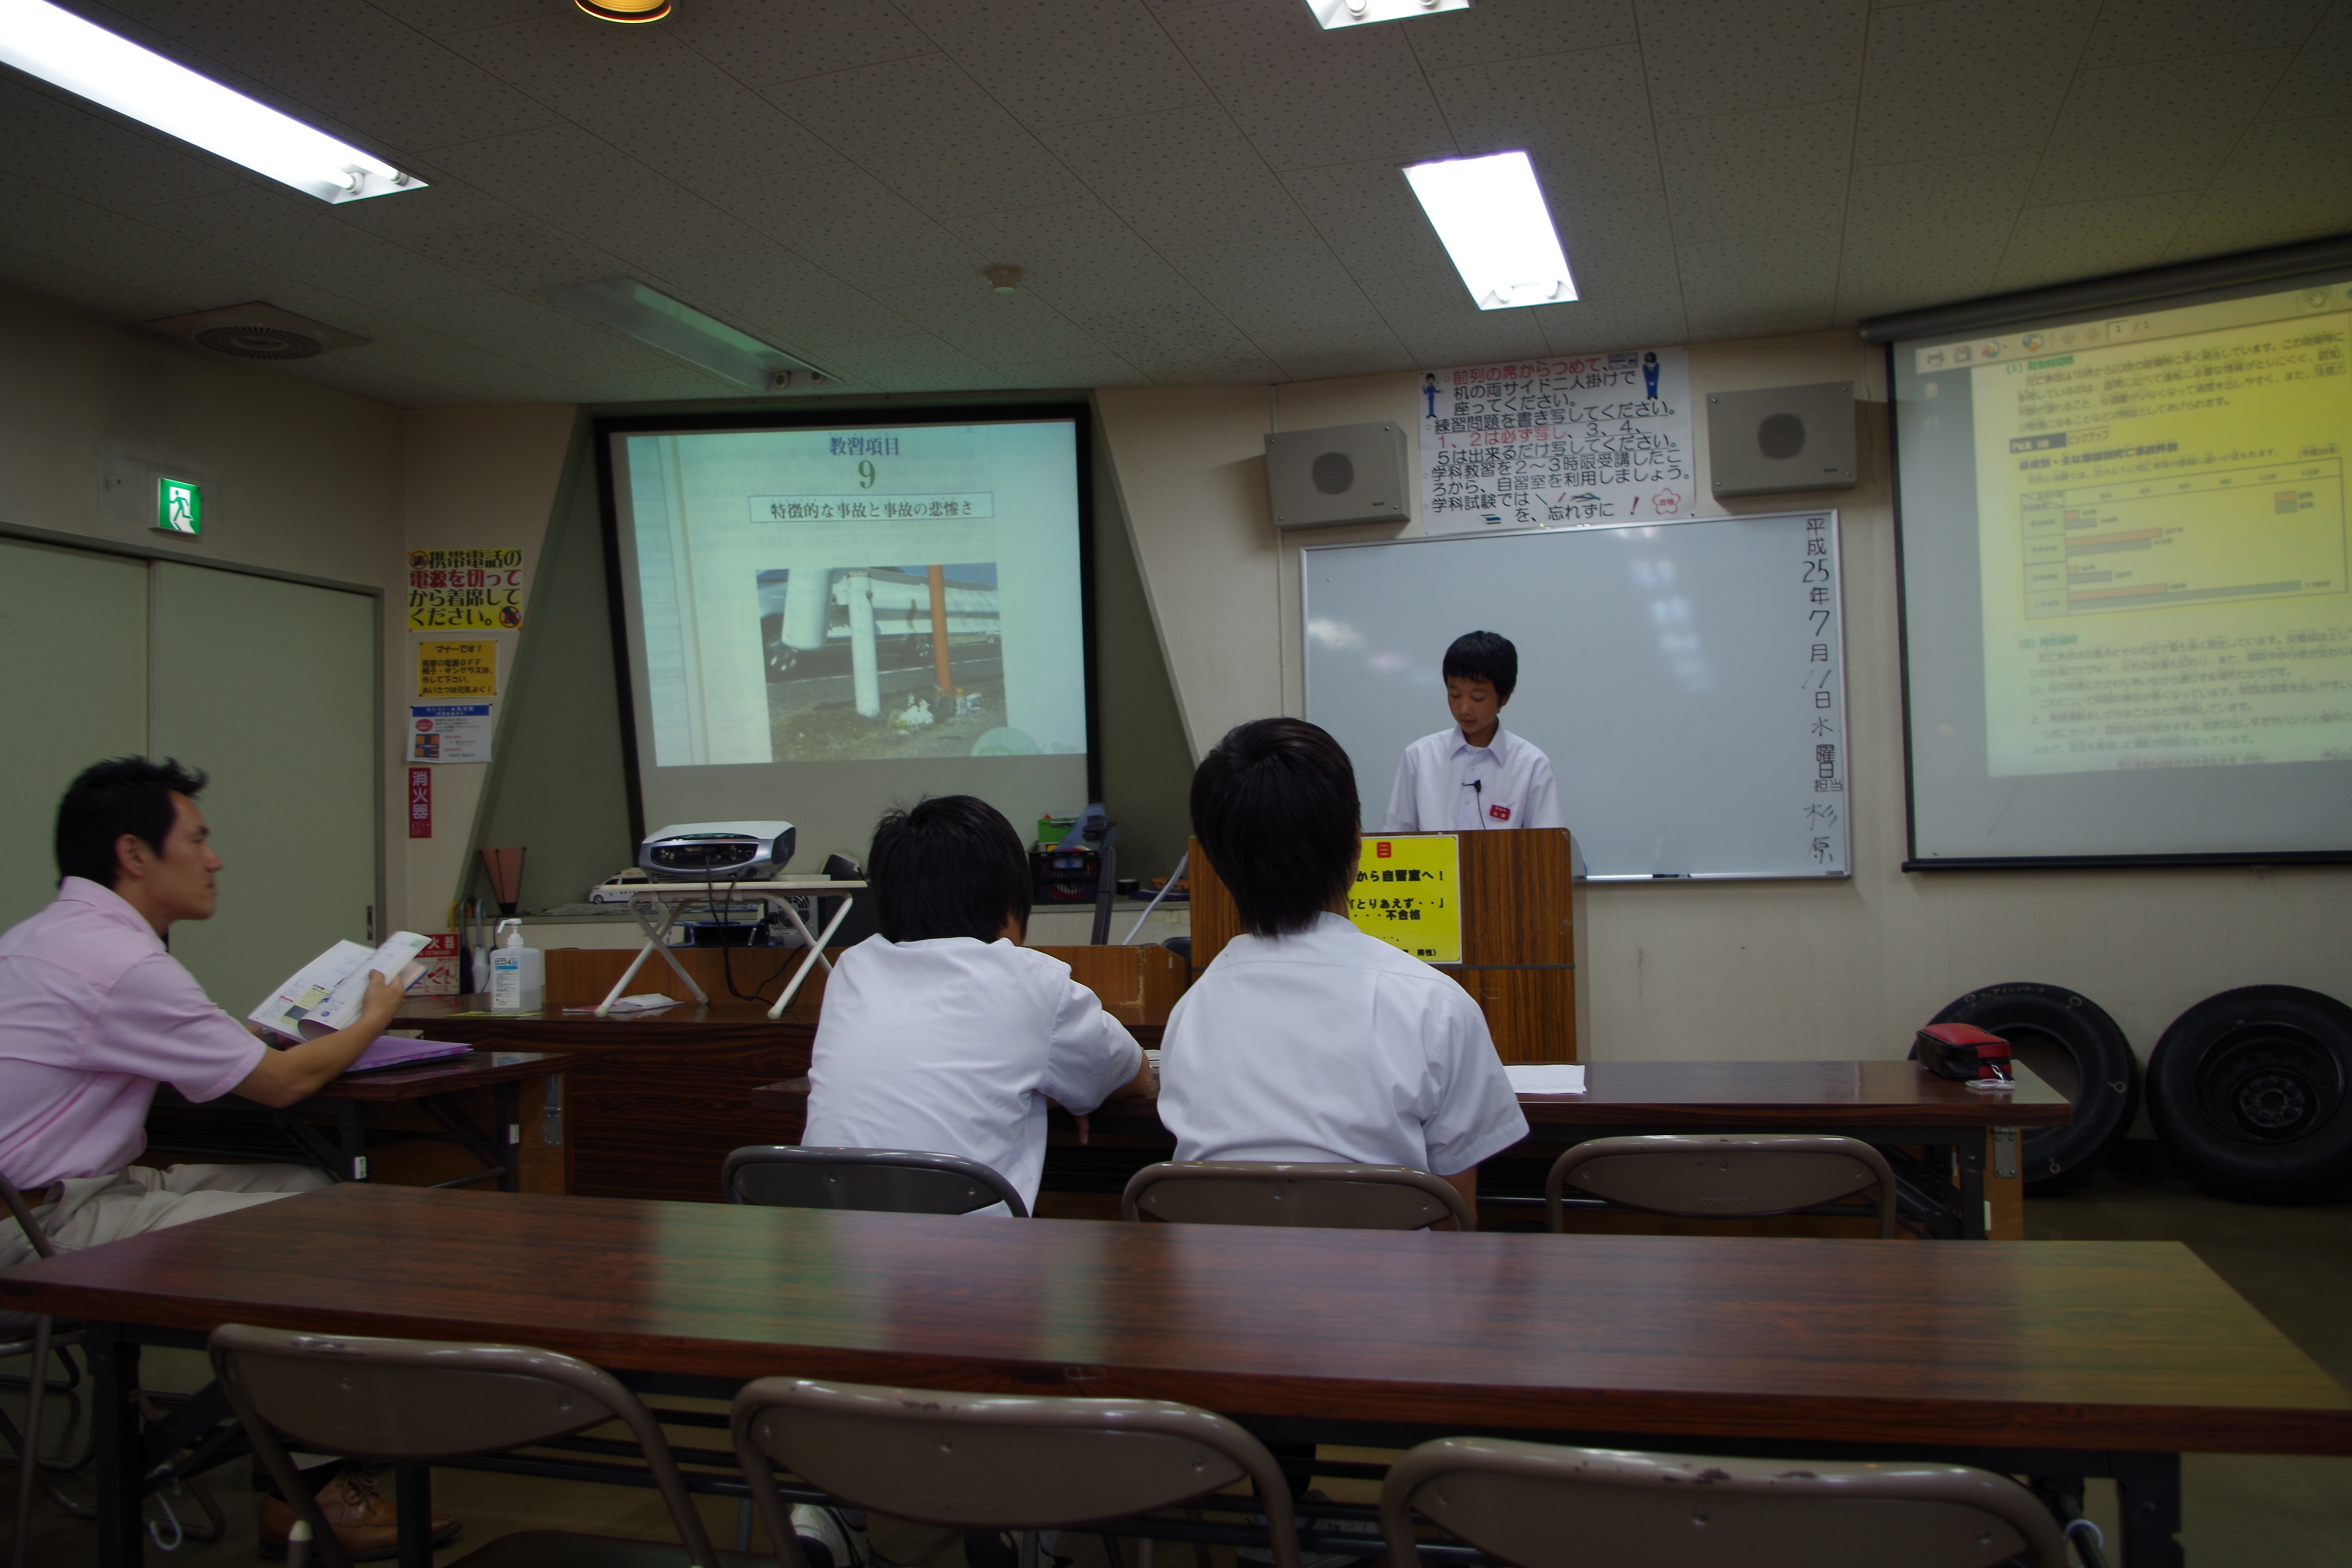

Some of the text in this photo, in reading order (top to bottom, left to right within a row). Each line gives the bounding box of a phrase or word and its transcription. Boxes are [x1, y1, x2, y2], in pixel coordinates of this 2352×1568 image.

[1453, 357, 1608, 385] 前列の席からつめて、
[1454, 393, 1575, 416] 座ってください。
[1434, 400, 1675, 433] 練習問題を書き写してください。
[830, 436, 899, 455] 教習項目
[858, 459, 876, 489] 9
[771, 501, 972, 519] 特徴的な事故と事故の悲惨さ
[1432, 491, 1530, 513] 学科試験では
[429, 550, 521, 569] 携帯電話の
[410, 570, 521, 589] 電源を切って
[409, 589, 521, 607] から着席して
[410, 608, 493, 626] ください。
[412, 771, 428, 820] 消火器
[428, 936, 455, 949] 火器
